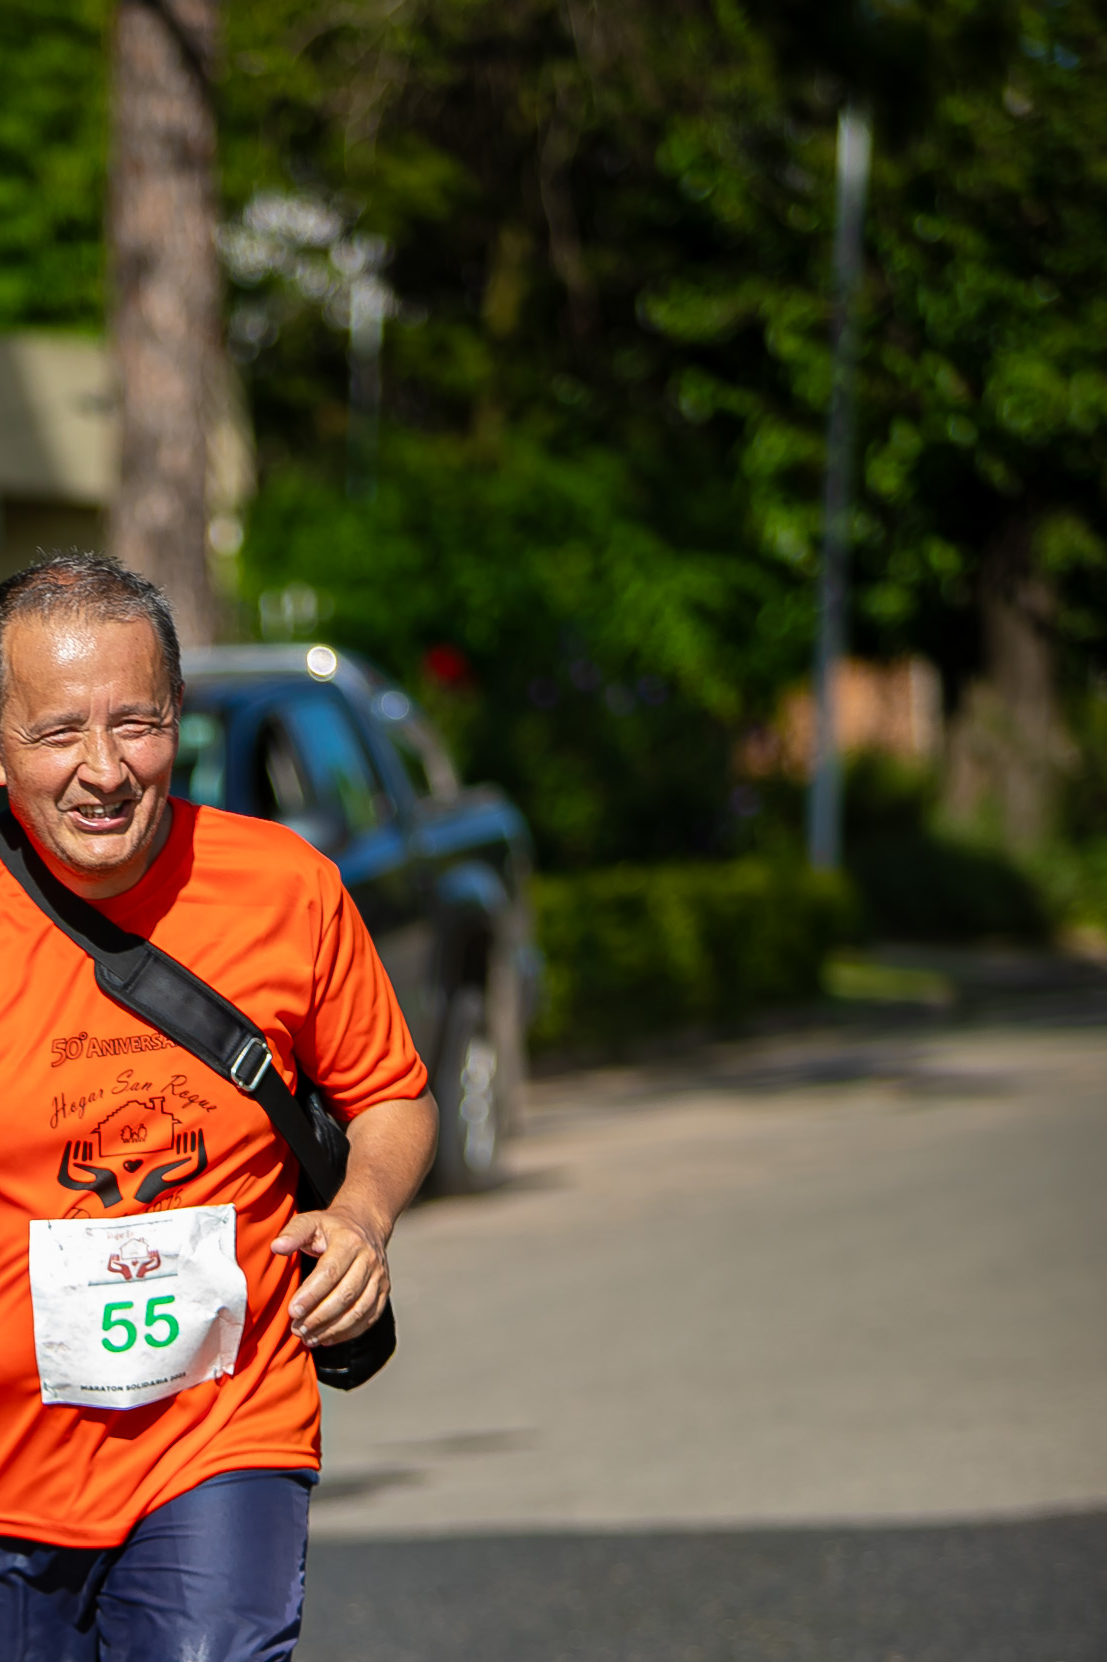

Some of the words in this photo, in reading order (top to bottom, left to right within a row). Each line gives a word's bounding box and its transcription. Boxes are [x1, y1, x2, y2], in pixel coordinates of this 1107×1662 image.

[86, 1033, 175, 1059] ANIVERSA
[50, 1089, 104, 1129] Hogar
[111, 1069, 152, 1095] San
[161, 1074, 217, 1113] Roque
[101, 1294, 180, 1353] 55
[126, 1377, 169, 1391] SOLIDARIA
